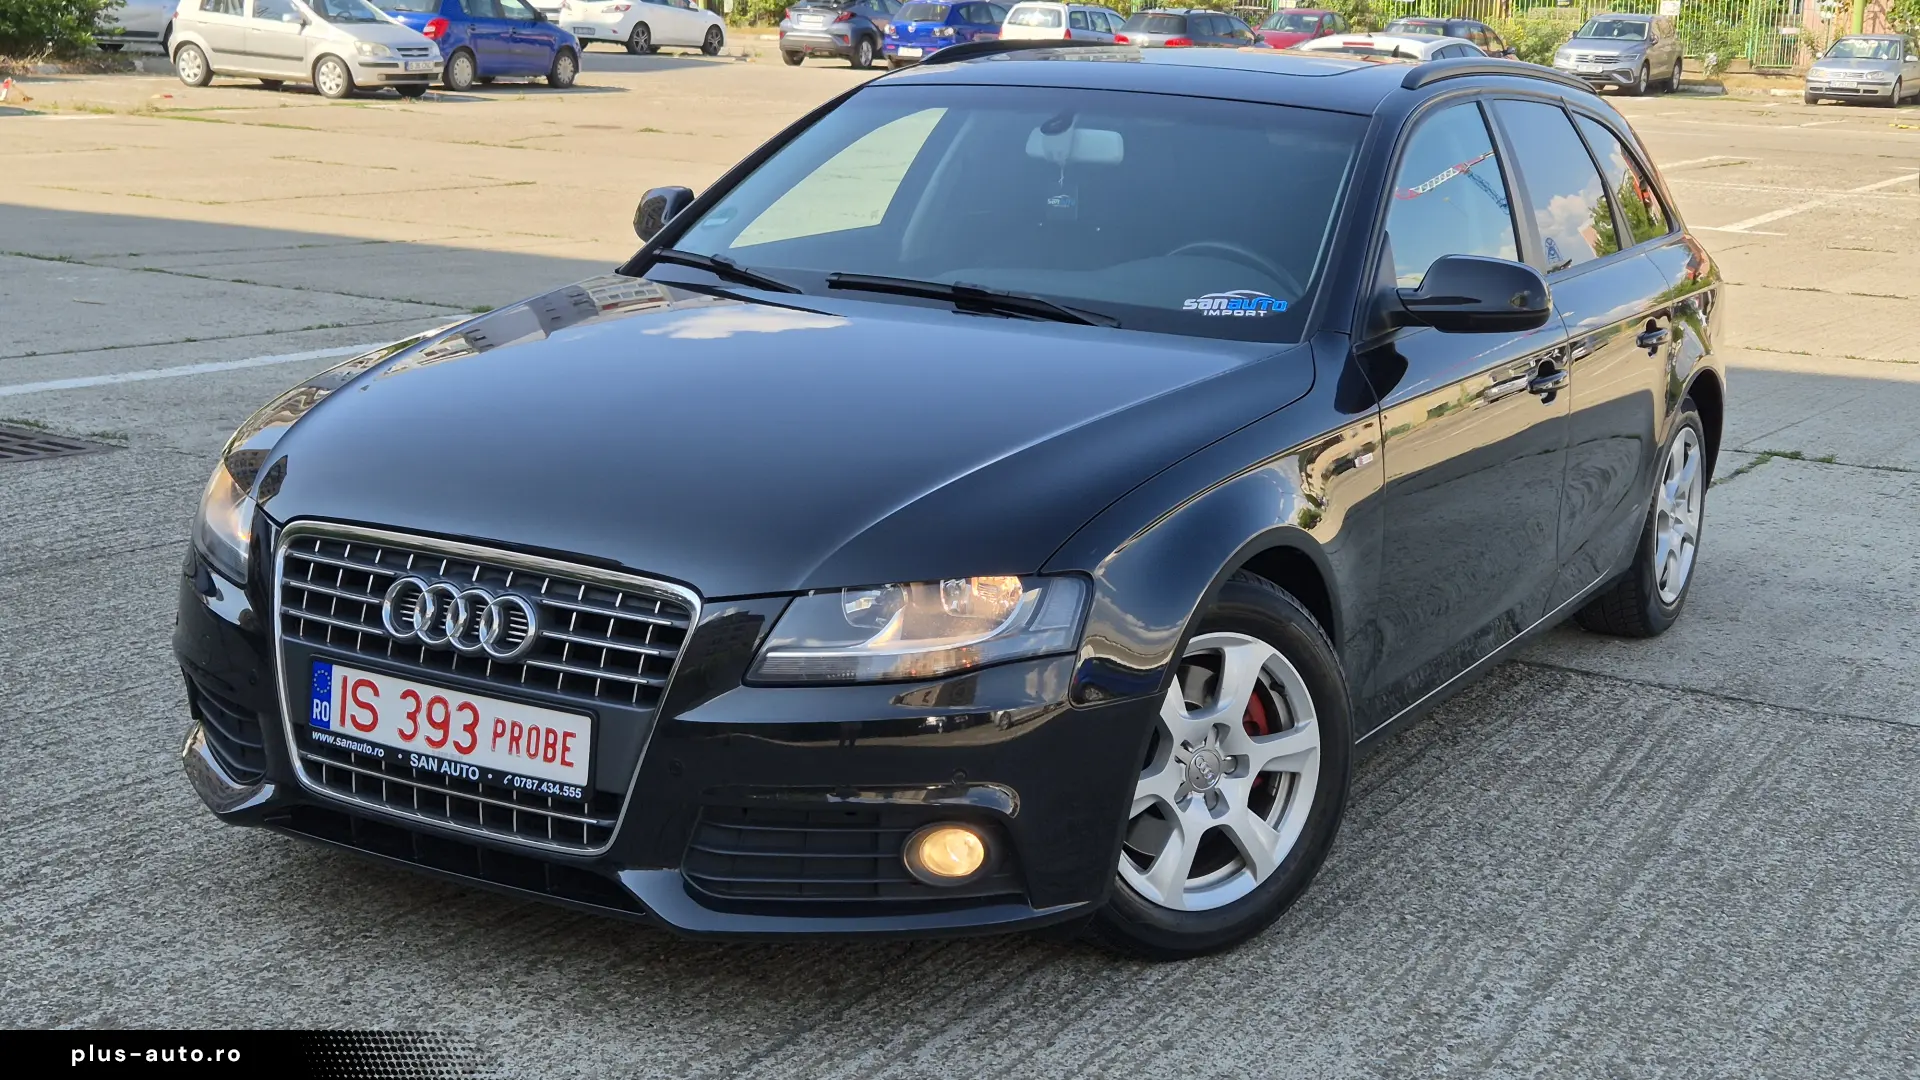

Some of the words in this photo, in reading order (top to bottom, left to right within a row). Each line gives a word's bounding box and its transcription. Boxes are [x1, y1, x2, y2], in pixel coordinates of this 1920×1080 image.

[312, 698, 331, 723] RO
[339, 675, 380, 733] IS
[397, 688, 480, 755] 393
[491, 716, 577, 768] PROBE
[312, 730, 385, 758] www.sanauto.ro
[410, 753, 438, 773] SAN
[440, 760, 480, 781] AUTO
[513, 776, 582, 799] 0787.434.555
